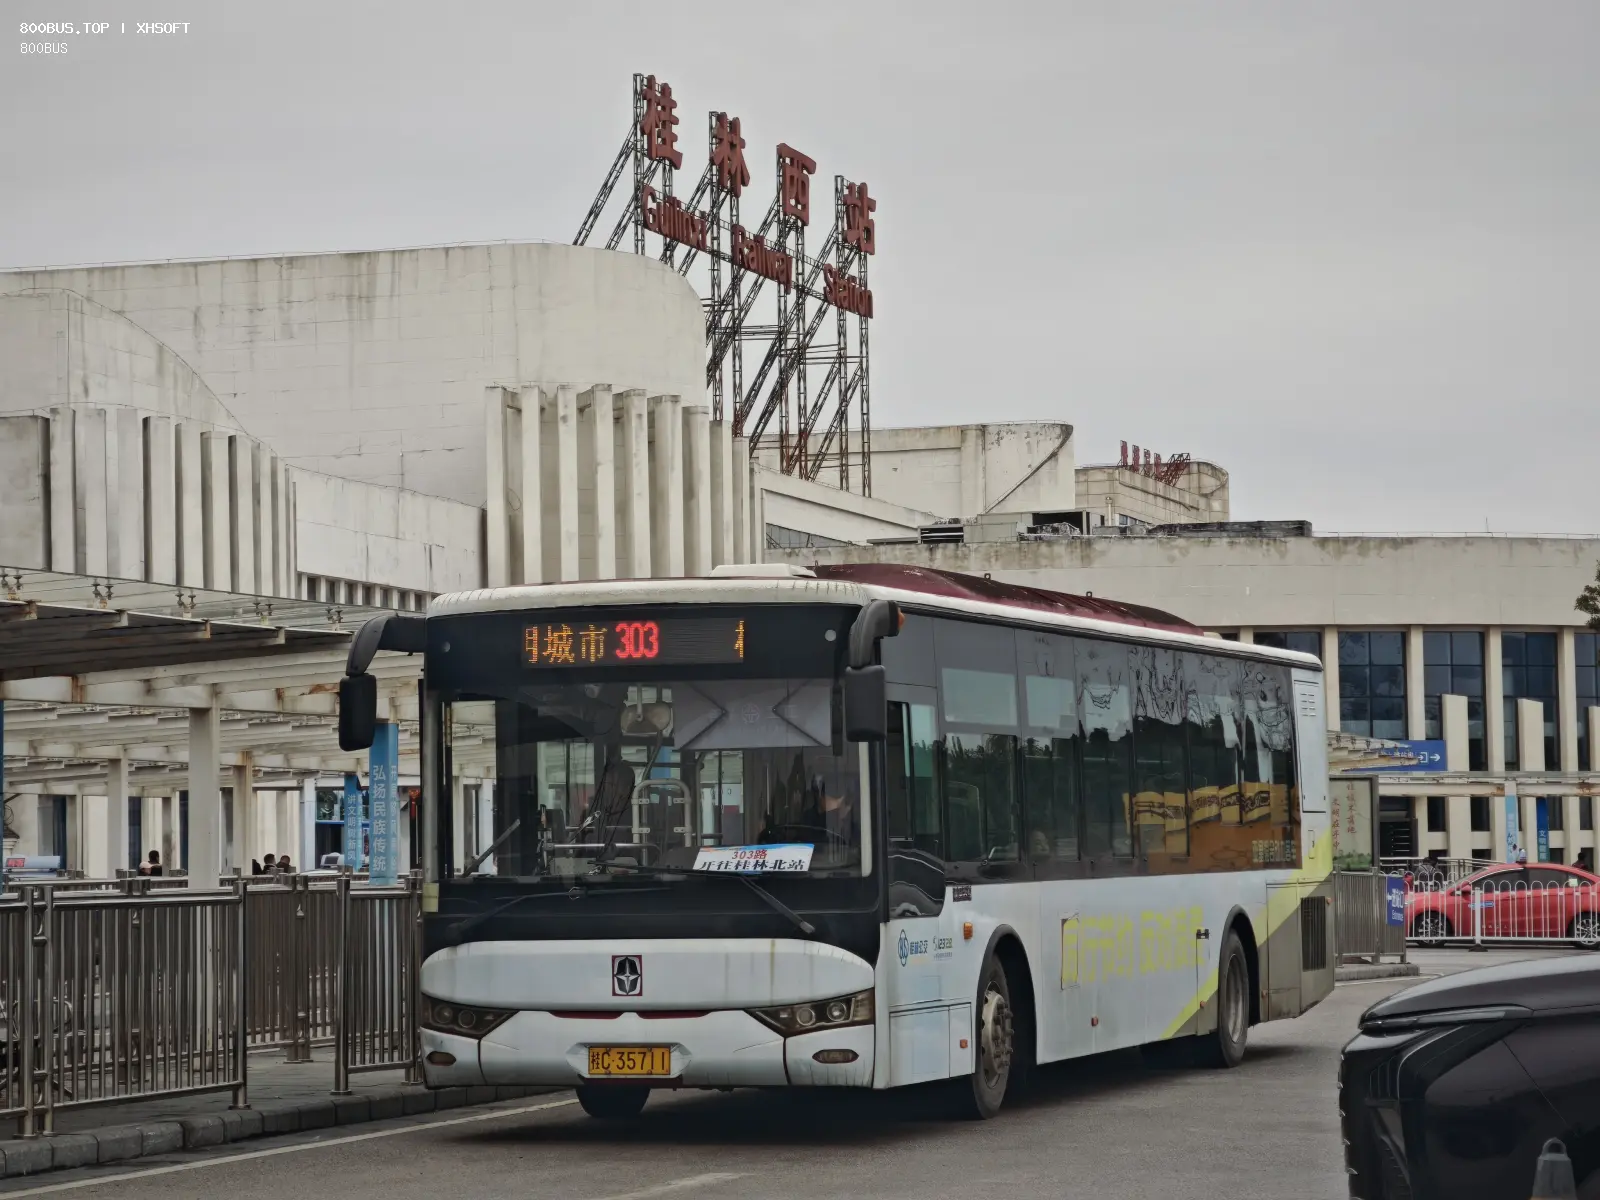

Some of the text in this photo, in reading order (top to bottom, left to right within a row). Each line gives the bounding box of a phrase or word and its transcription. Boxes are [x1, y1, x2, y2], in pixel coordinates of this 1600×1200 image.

[640, 75, 876, 255] 桂林西站
[731, 224, 792, 295] Railway
[823, 264, 874, 319] Station
[615, 621, 659, 659] 303
[347, 794, 357, 861] 讲文明树新风
[373, 765, 387, 872] 弘扬民族传统
[700, 859, 805, 870] 开往桂林北站
[732, 849, 768, 859] 303路
